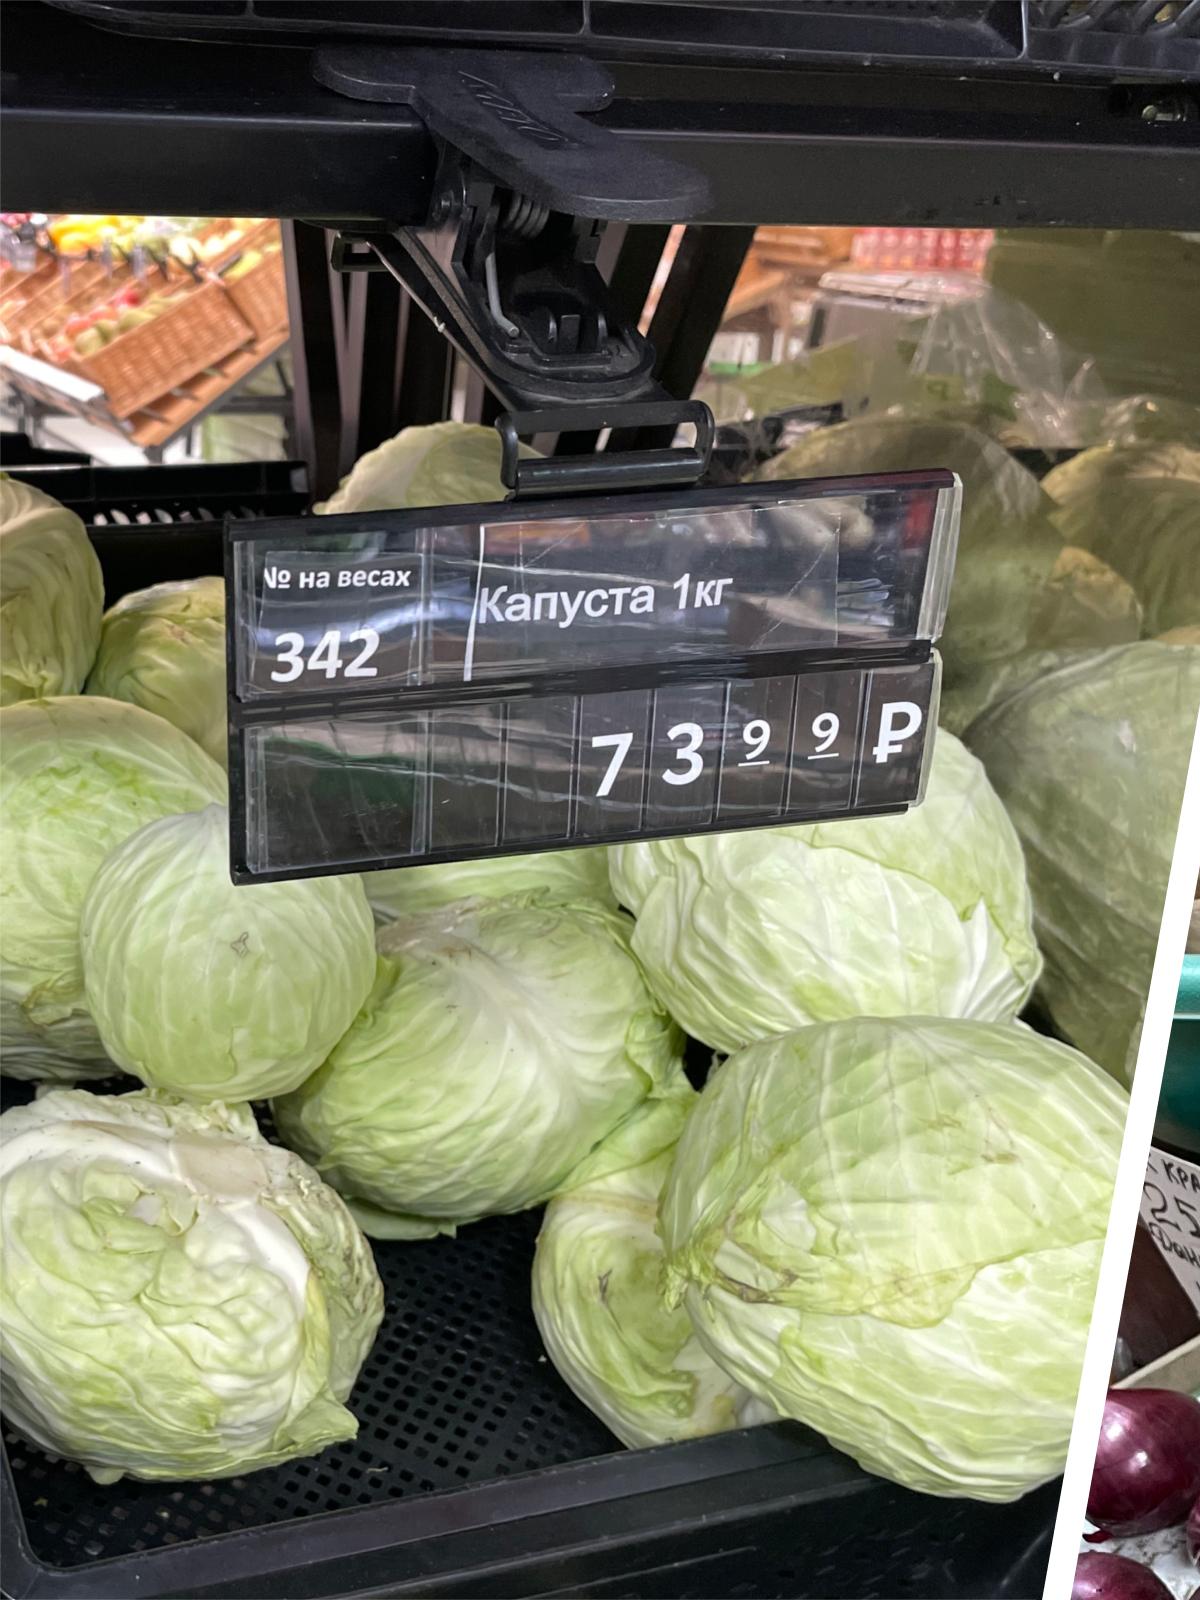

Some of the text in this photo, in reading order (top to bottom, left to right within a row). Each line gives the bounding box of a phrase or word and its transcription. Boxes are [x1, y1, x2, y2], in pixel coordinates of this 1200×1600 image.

[299, 570, 331, 588] на
[337, 568, 412, 588] весах
[478, 573, 734, 629] Капуста 1кг
[270, 627, 381, 683] 342
